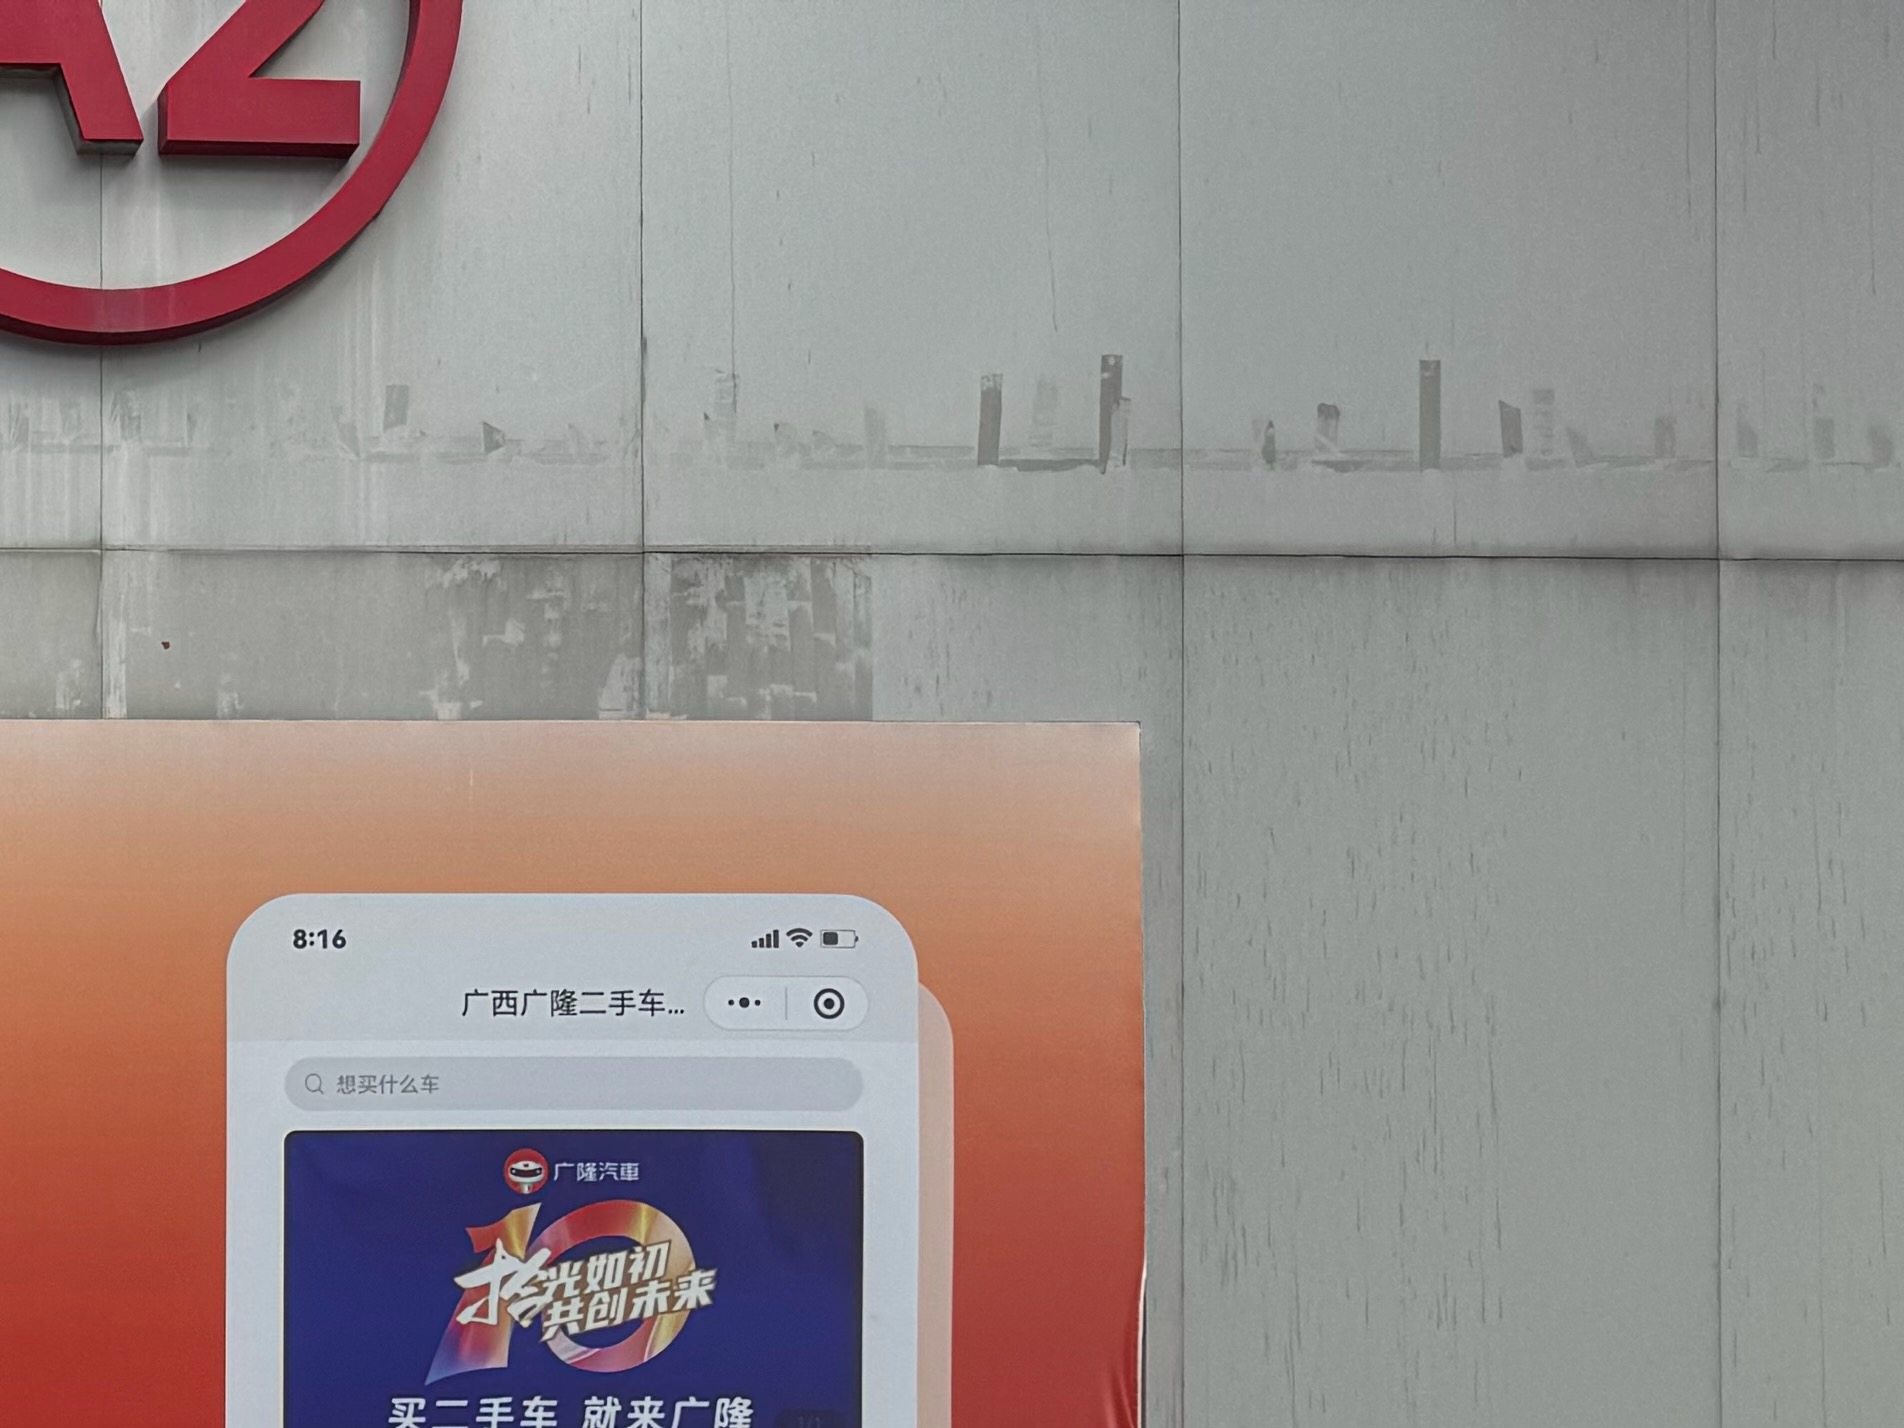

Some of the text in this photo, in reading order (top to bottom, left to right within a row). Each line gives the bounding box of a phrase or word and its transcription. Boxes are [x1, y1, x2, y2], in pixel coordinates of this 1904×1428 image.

[292, 929, 347, 950] 8:16
[335, 1073, 440, 1096] 想买什么车
